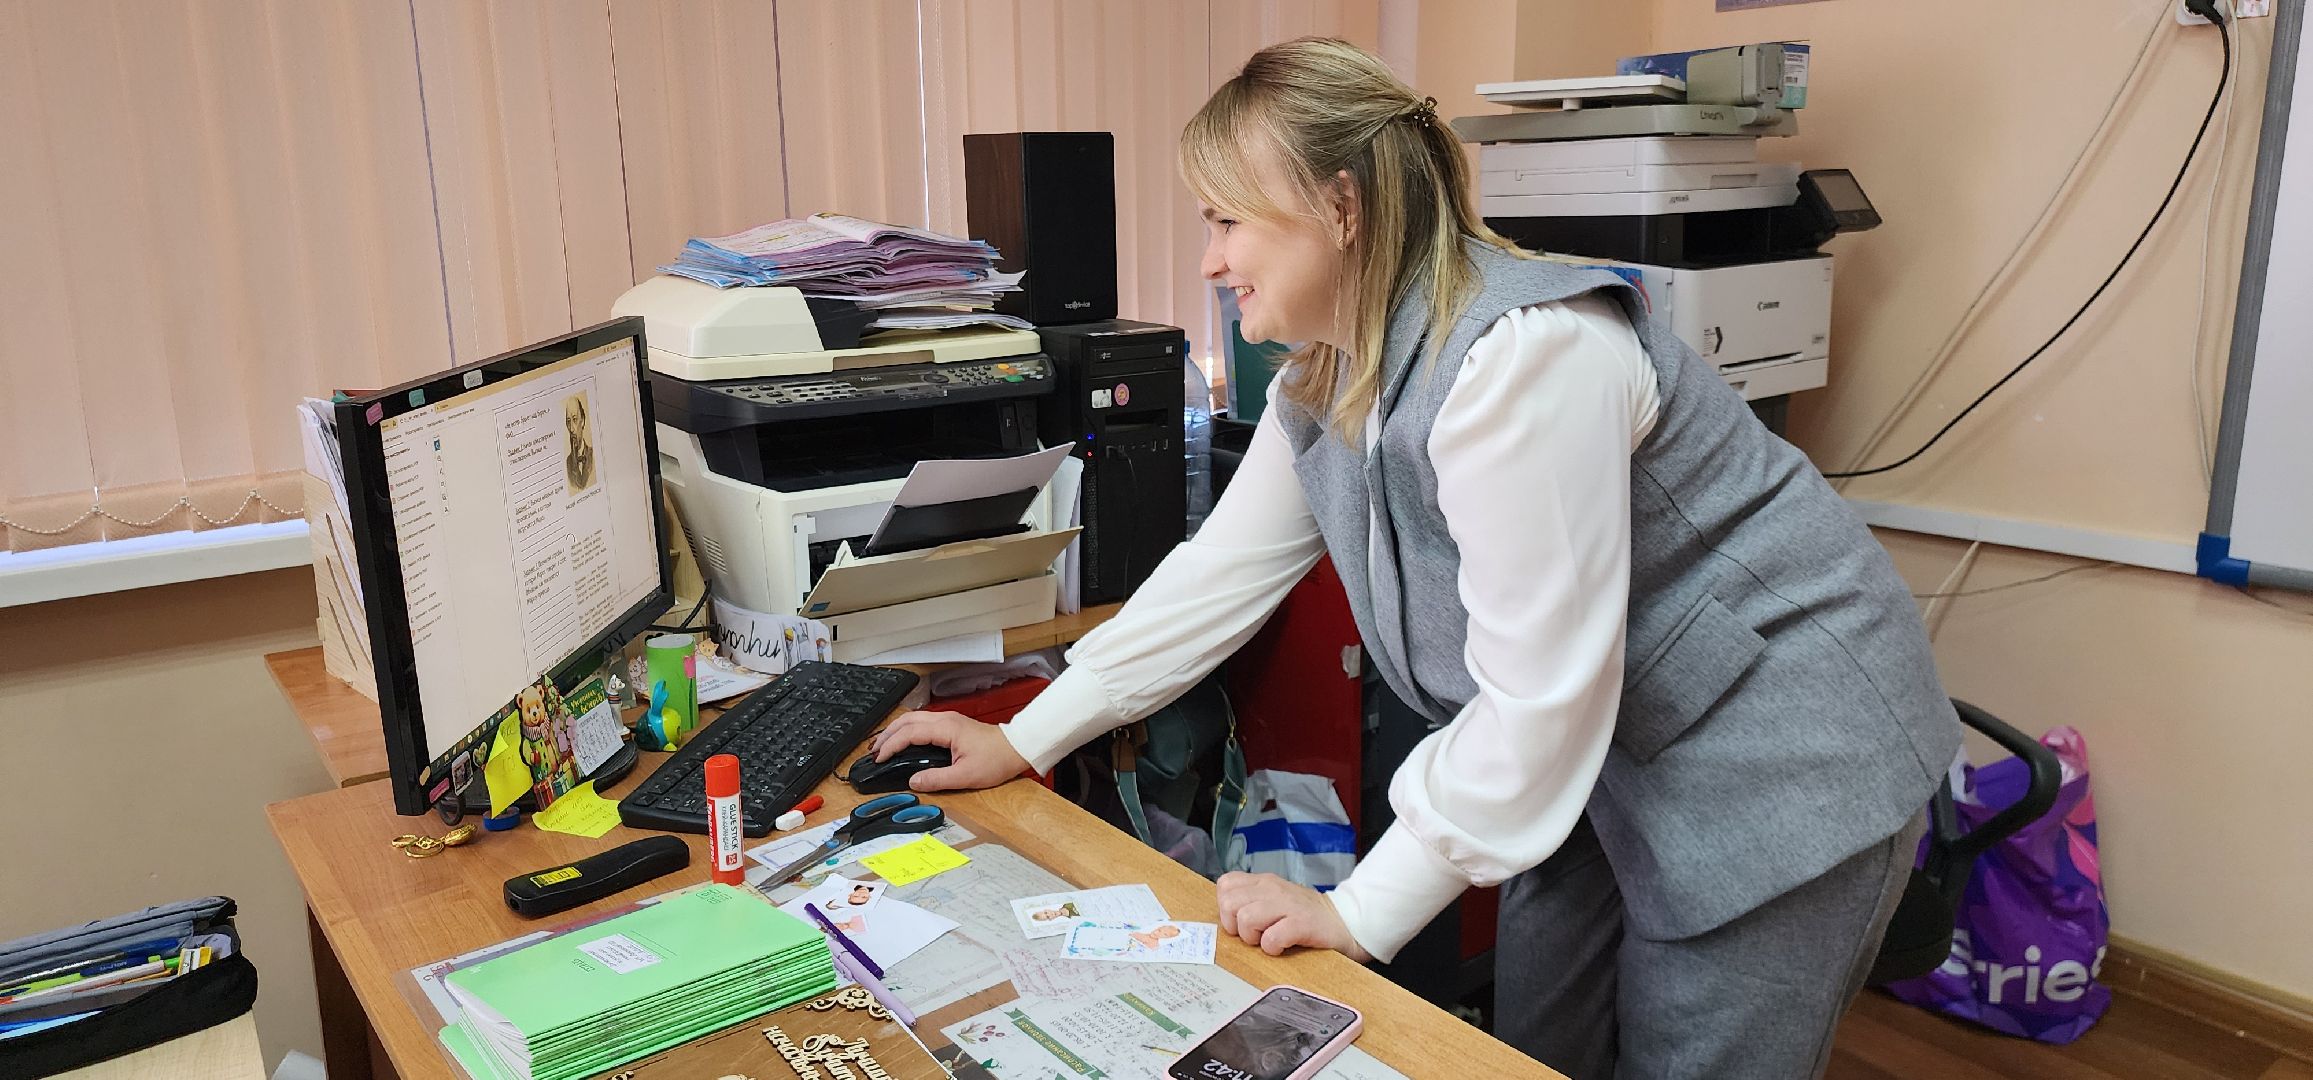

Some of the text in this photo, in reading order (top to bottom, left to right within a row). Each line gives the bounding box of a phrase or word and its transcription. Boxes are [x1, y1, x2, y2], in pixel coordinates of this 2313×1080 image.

[729, 803, 739, 850] GLUE STICK
[1042, 1039, 1086, 1073] Расписание
